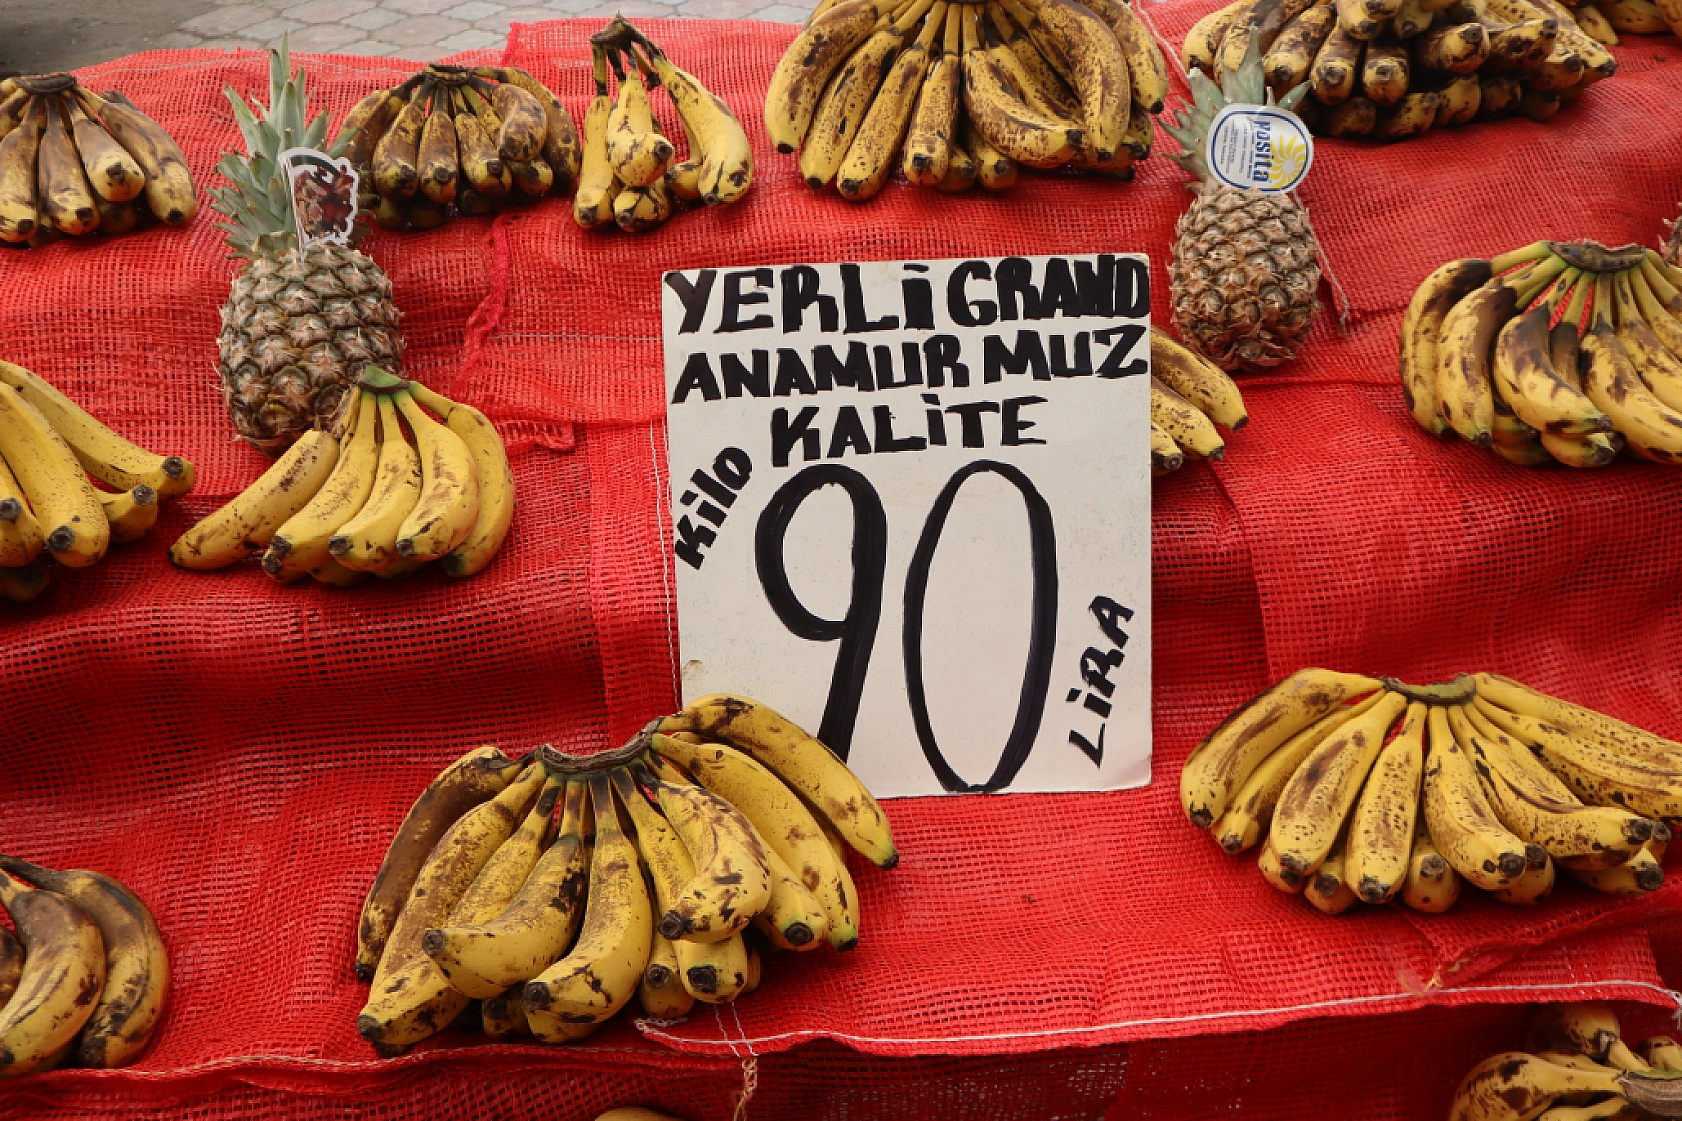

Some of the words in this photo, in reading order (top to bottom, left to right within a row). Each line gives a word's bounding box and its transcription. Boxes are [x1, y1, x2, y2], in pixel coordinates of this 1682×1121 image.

[947, 254, 1151, 328] GRAND
[671, 333, 970, 405] ANAMUR
[982, 324, 1149, 383] MUZ
[754, 458, 1059, 794] 90
